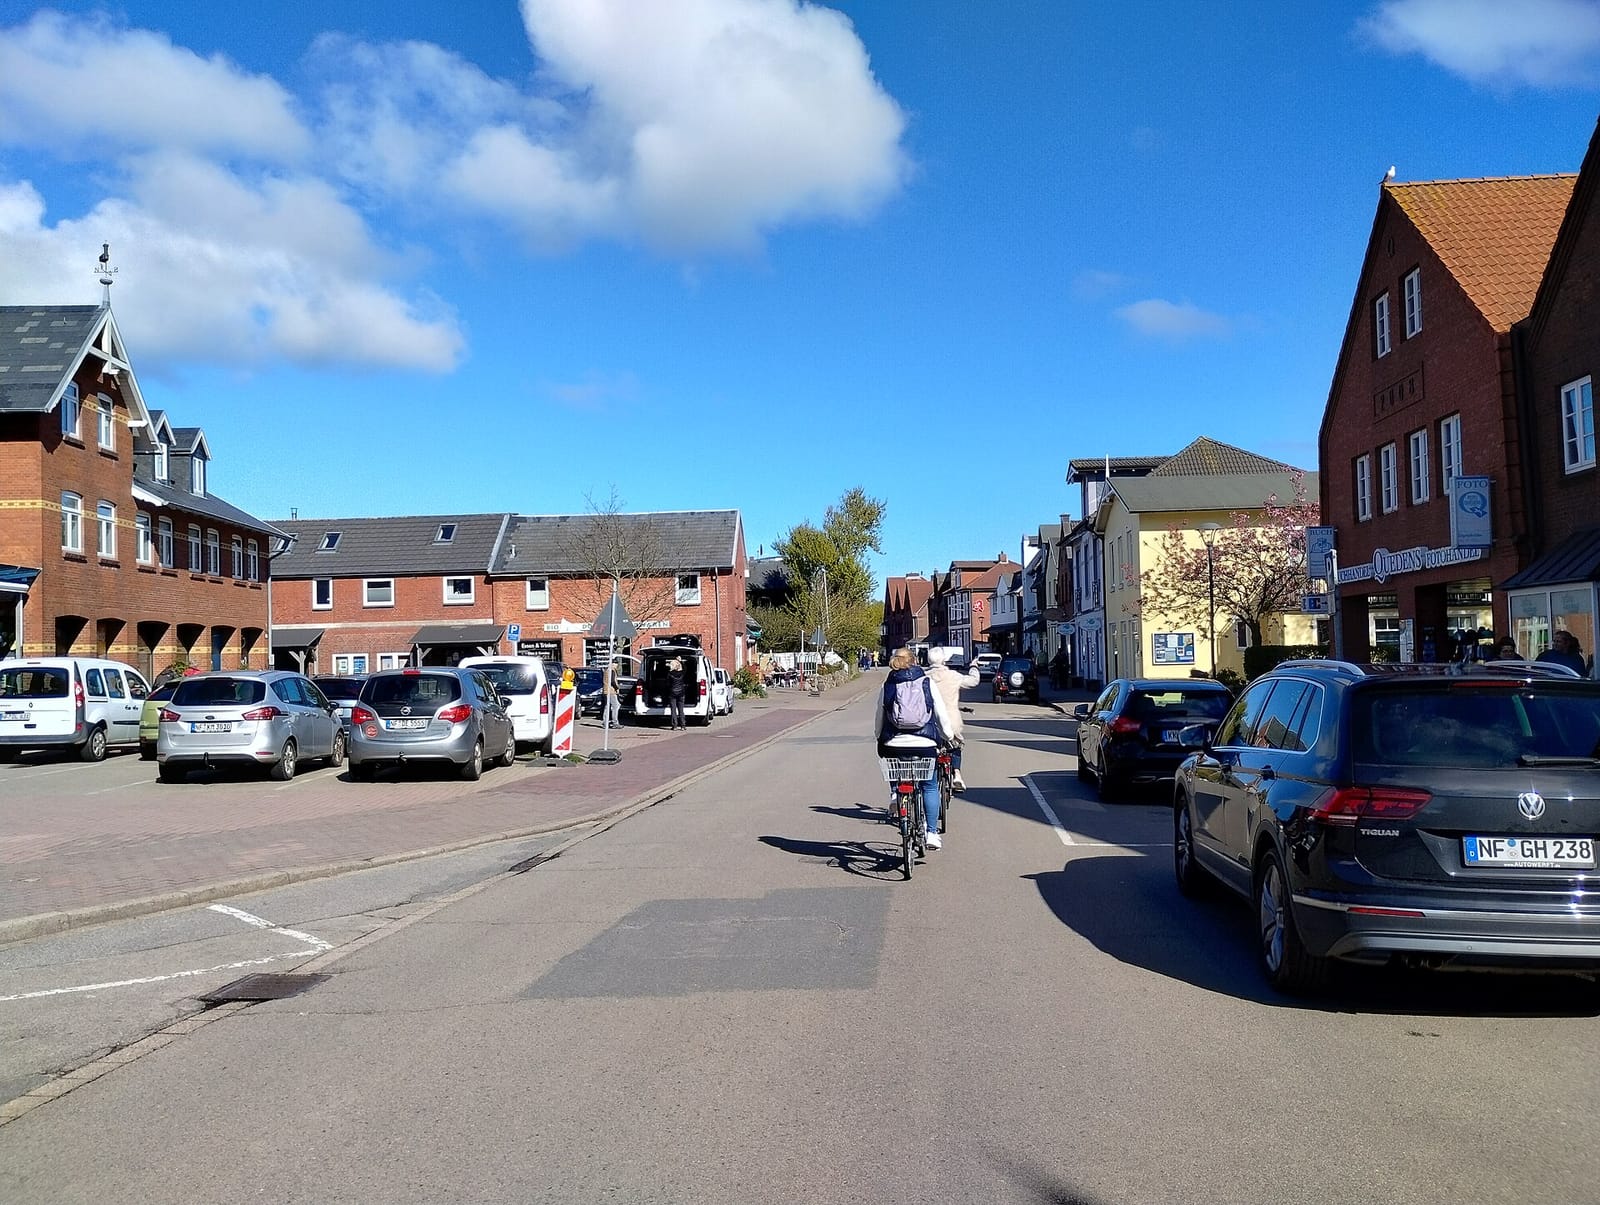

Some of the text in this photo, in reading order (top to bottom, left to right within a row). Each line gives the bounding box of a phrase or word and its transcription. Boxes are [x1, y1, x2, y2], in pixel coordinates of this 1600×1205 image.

[1457, 480, 1488, 489] FOTO
[1338, 565, 1371, 582] UCHHANDEL
[1373, 549, 1423, 581] QUEDENS
[1425, 548, 1481, 567] FOTOHANDEL
[511, 625, 519, 634] P
[1480, 840, 1592, 860] NF GH 238
